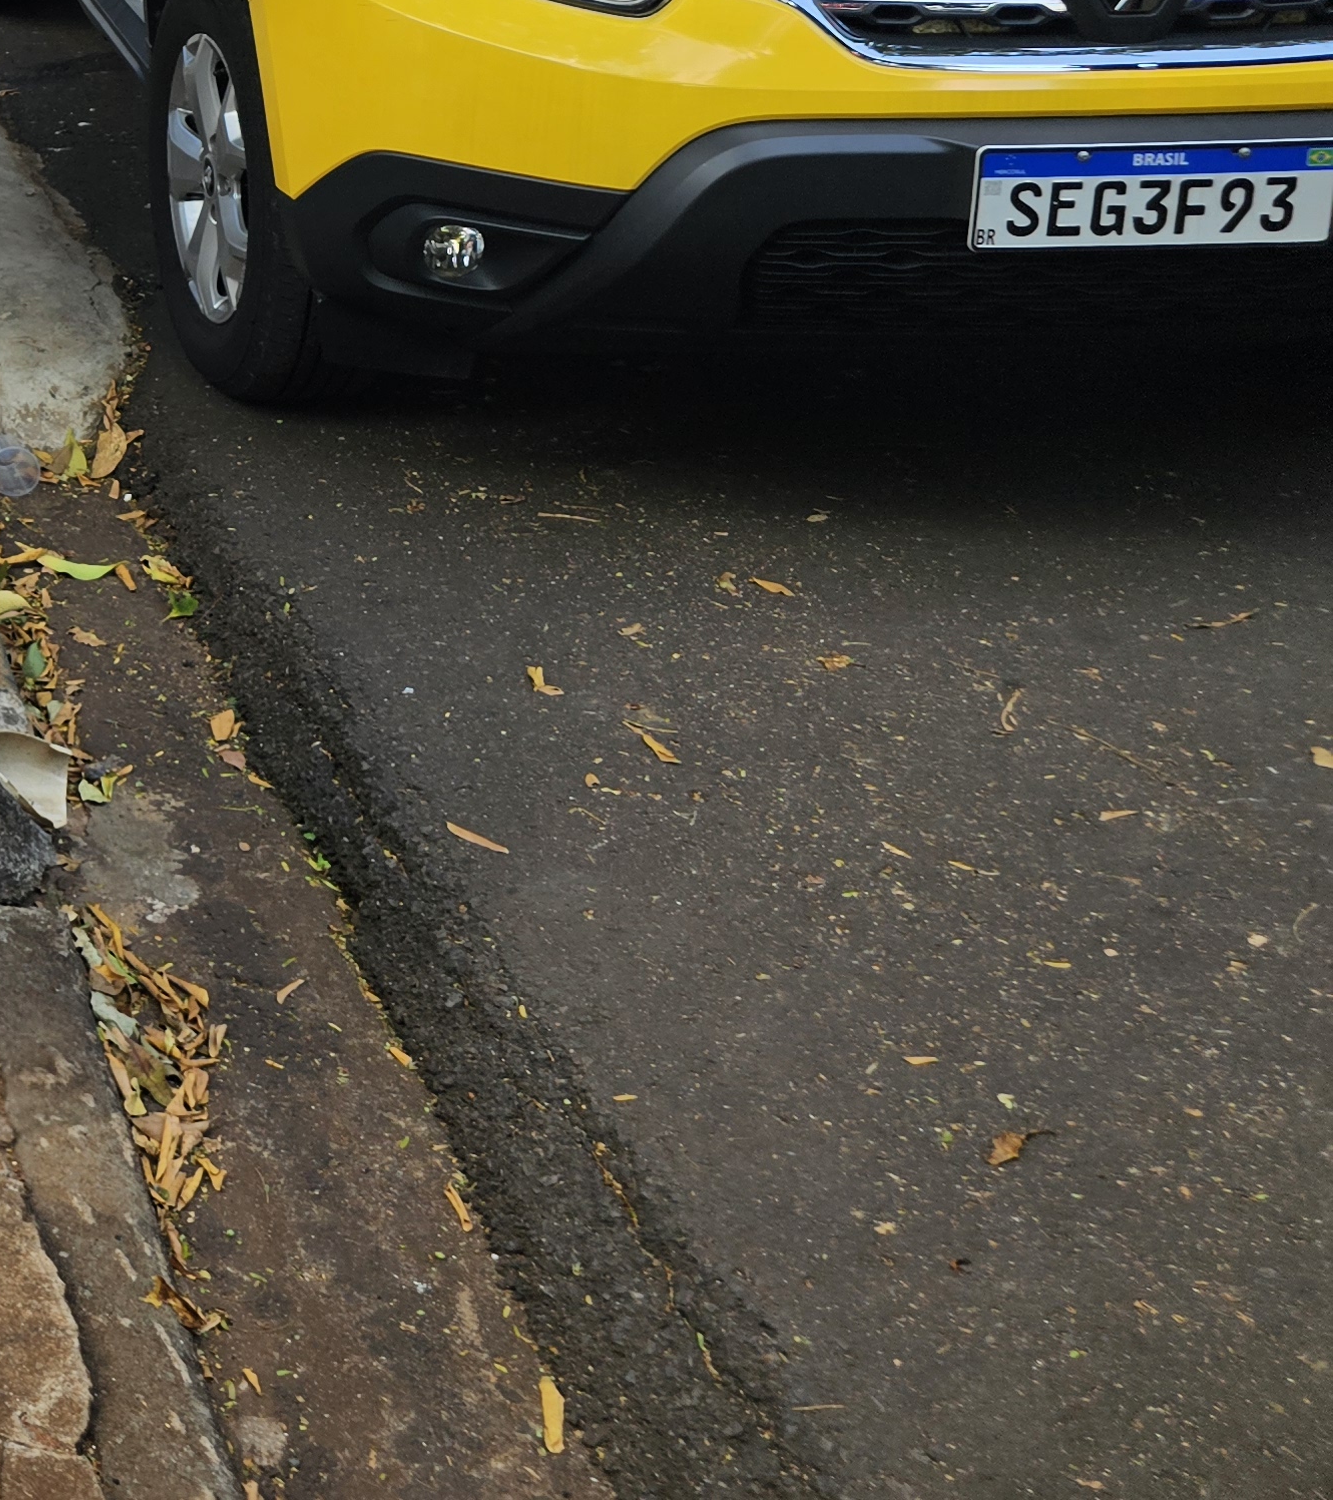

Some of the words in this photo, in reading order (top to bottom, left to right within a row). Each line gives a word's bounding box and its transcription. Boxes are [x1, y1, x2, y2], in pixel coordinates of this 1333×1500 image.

[1133, 152, 1190, 167] BRASIL
[1006, 176, 1298, 237] SEG3F93
[976, 229, 996, 246] BR
